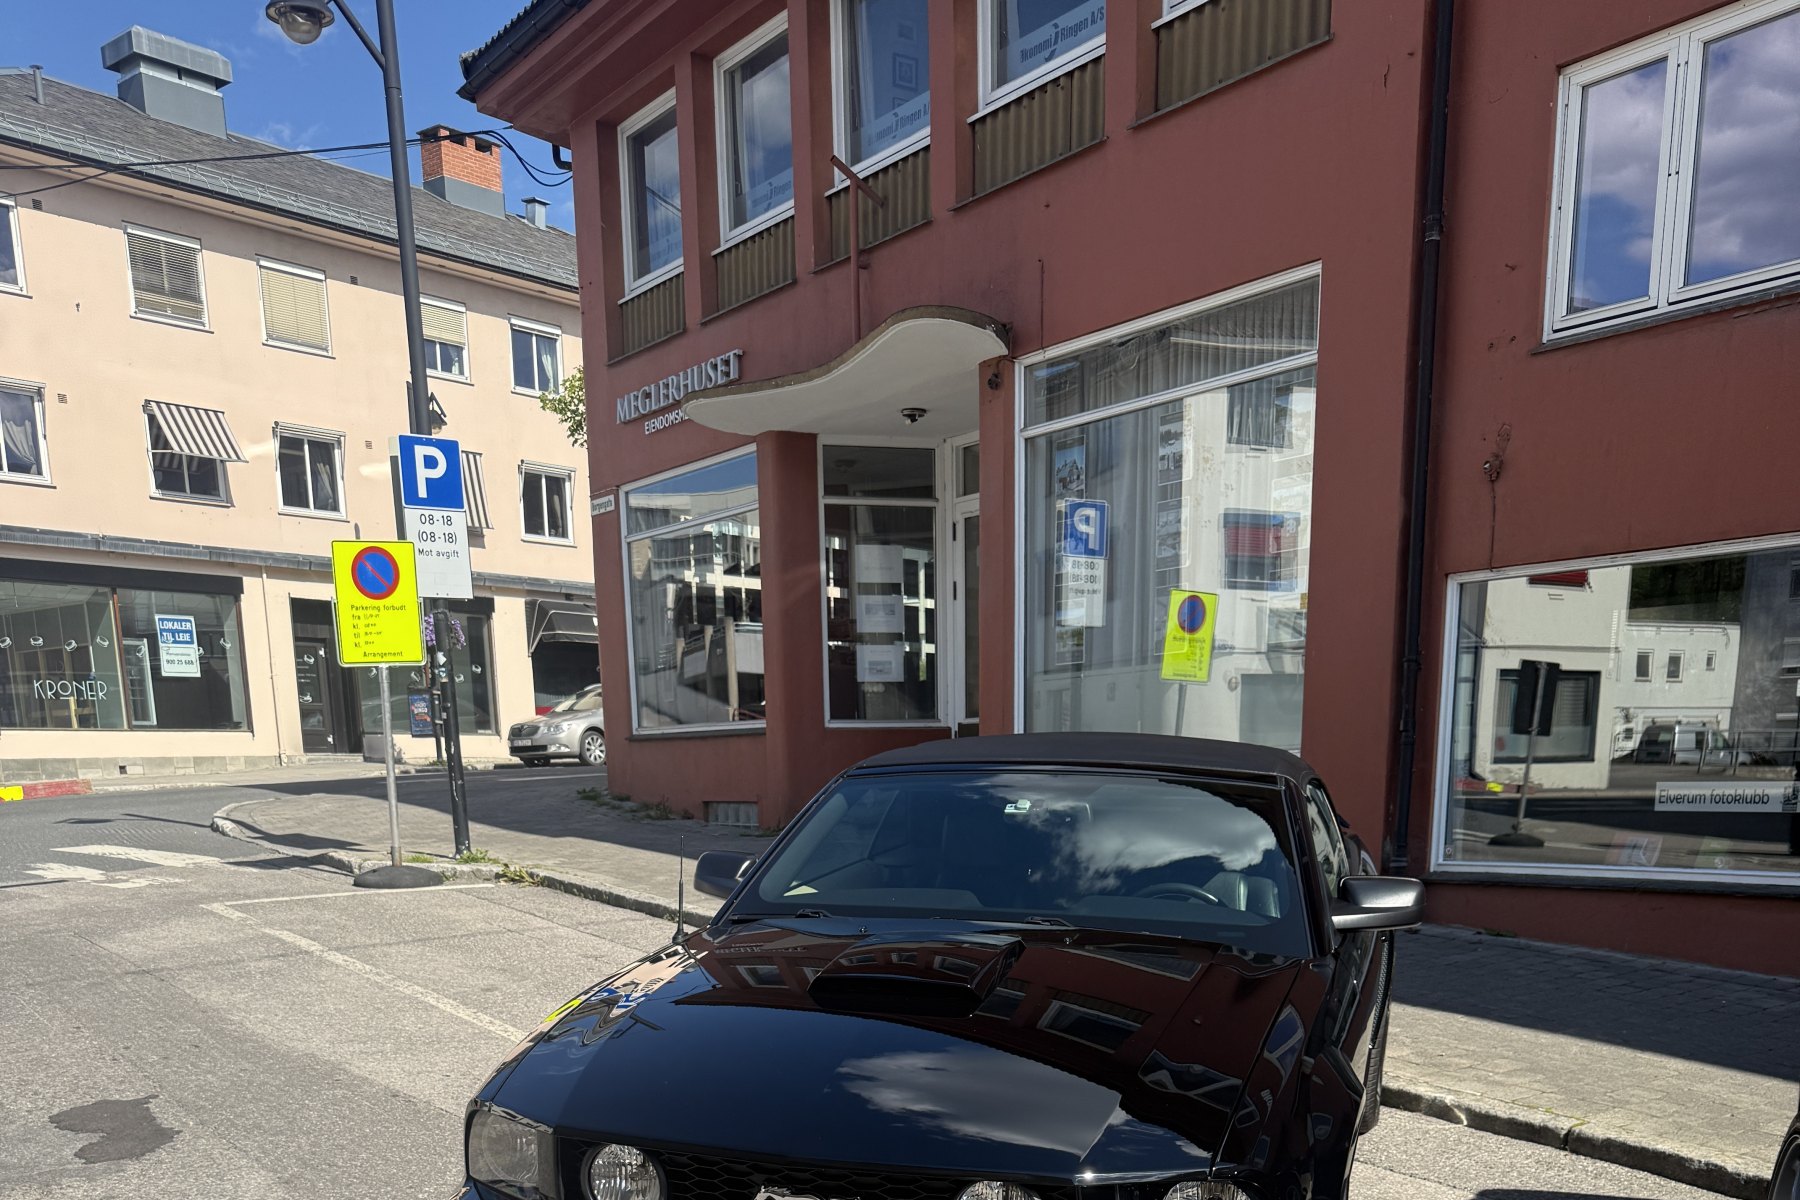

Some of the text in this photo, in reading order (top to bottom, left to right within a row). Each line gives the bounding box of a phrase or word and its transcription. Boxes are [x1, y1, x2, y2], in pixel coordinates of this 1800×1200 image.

[1060, 17, 1089, 42] Ringen
[1090, 6, 1105, 26] A/S
[615, 349, 743, 424] MEGLERHUSET
[414, 445, 447, 498] P
[419, 513, 453, 527] 08-18
[417, 530, 457, 545] (08-18)
[418, 548, 460, 560] Mot avgift
[350, 604, 381, 612] Parkering
[159, 620, 192, 630] LOKALER
[162, 632, 191, 641] TIL LEIE
[363, 651, 403, 659] Arrangement
[33, 679, 107, 700] KRONER
[1658, 788, 1706, 804] Elverum
[1709, 788, 1770, 805] fotoklubb
